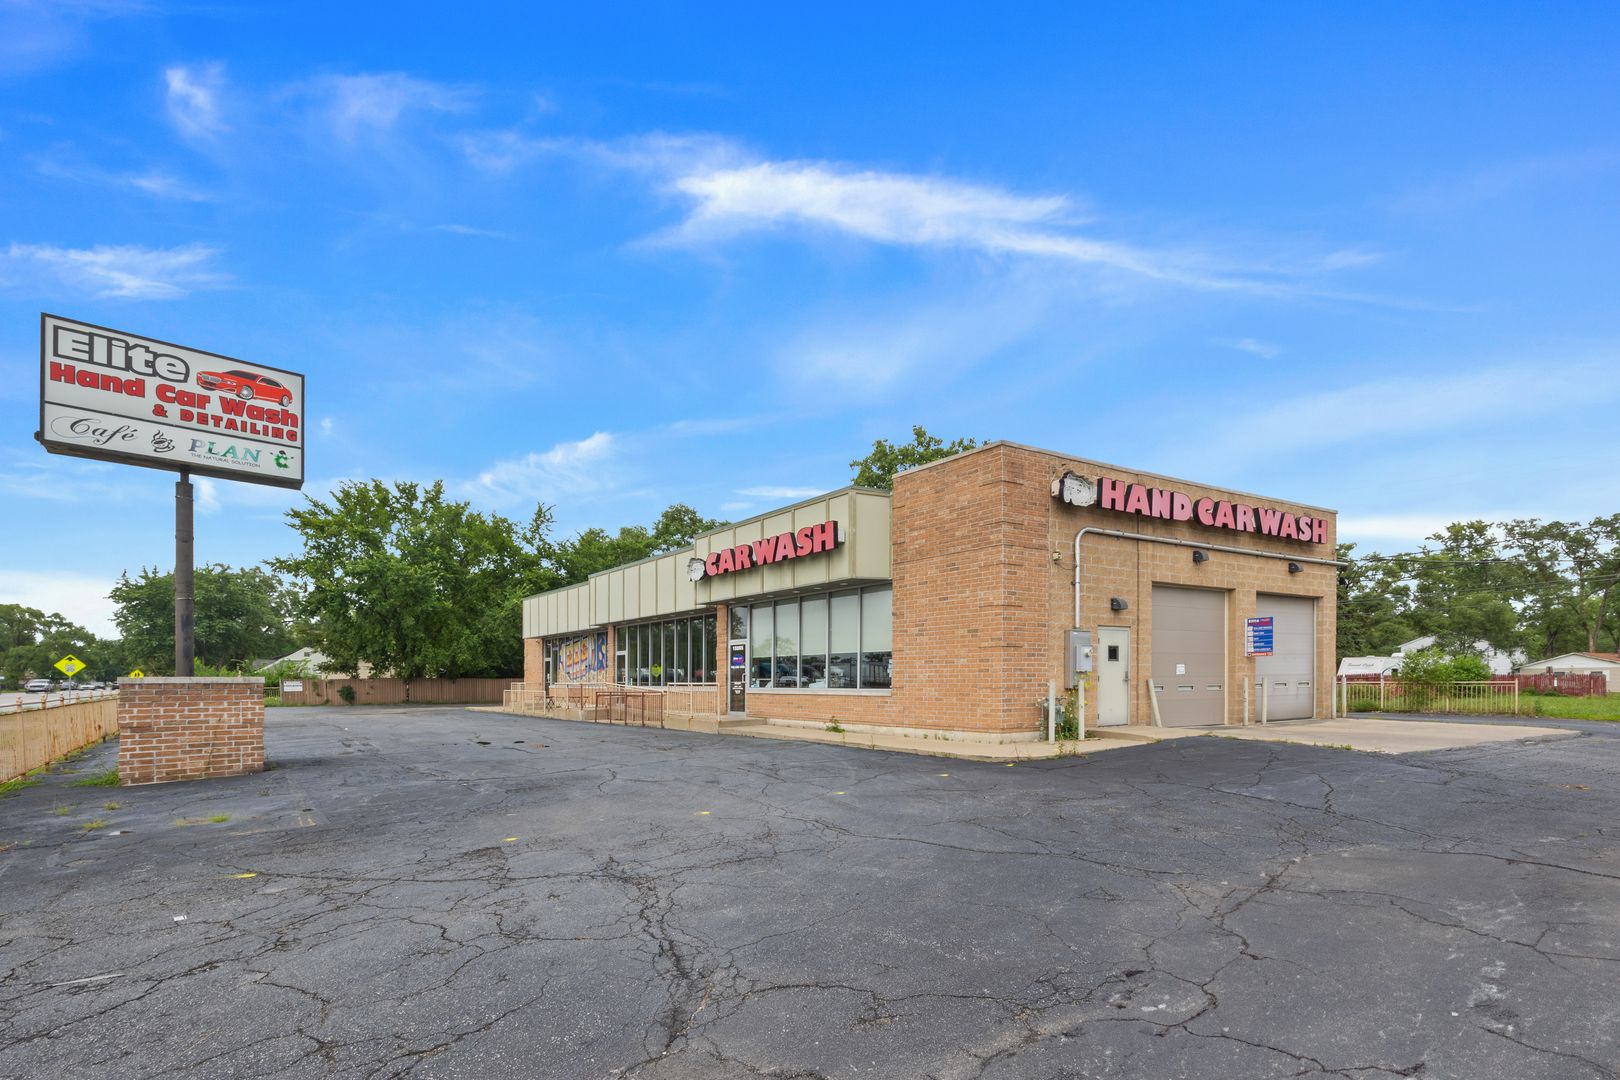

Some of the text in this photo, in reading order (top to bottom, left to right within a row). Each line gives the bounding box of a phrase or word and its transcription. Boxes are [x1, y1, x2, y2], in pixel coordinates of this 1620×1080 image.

[53, 324, 190, 383] Elite
[50, 361, 299, 428] Hand Car Wash
[51, 416, 138, 445] Café
[152, 404, 298, 442] & DETAILING
[188, 438, 262, 463] PLAN
[203, 455, 229, 464] NATURAL
[231, 460, 261, 468] SOLUTION
[1099, 477, 1329, 545] HAND CAR WASH
[705, 520, 837, 577] CAR WASH
